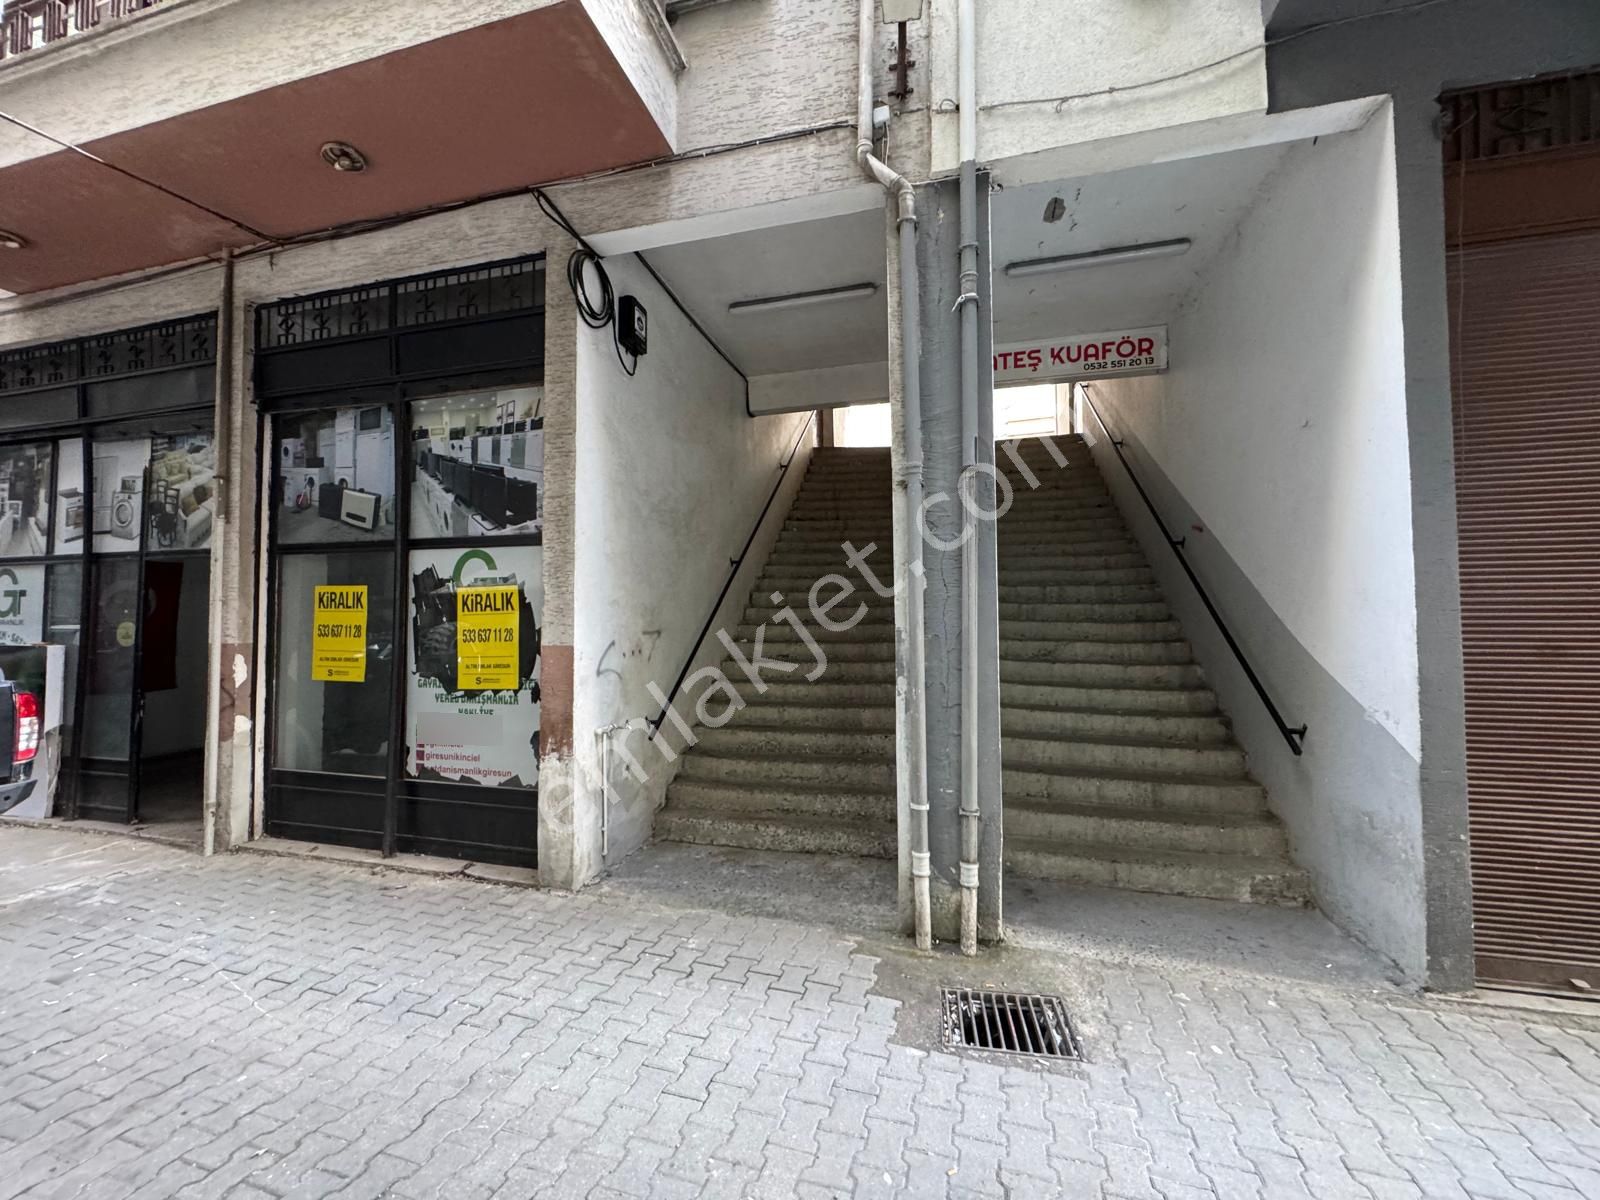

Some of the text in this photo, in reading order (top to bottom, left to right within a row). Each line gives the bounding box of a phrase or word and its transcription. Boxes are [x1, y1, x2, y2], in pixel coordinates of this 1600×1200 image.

[1051, 336, 1154, 365] KUAFÖR
[1084, 356, 1154, 371] 0532 551 20 13
[317, 624, 362, 638] 533 637 11 28
[462, 628, 513, 643] 533 637 11 28
